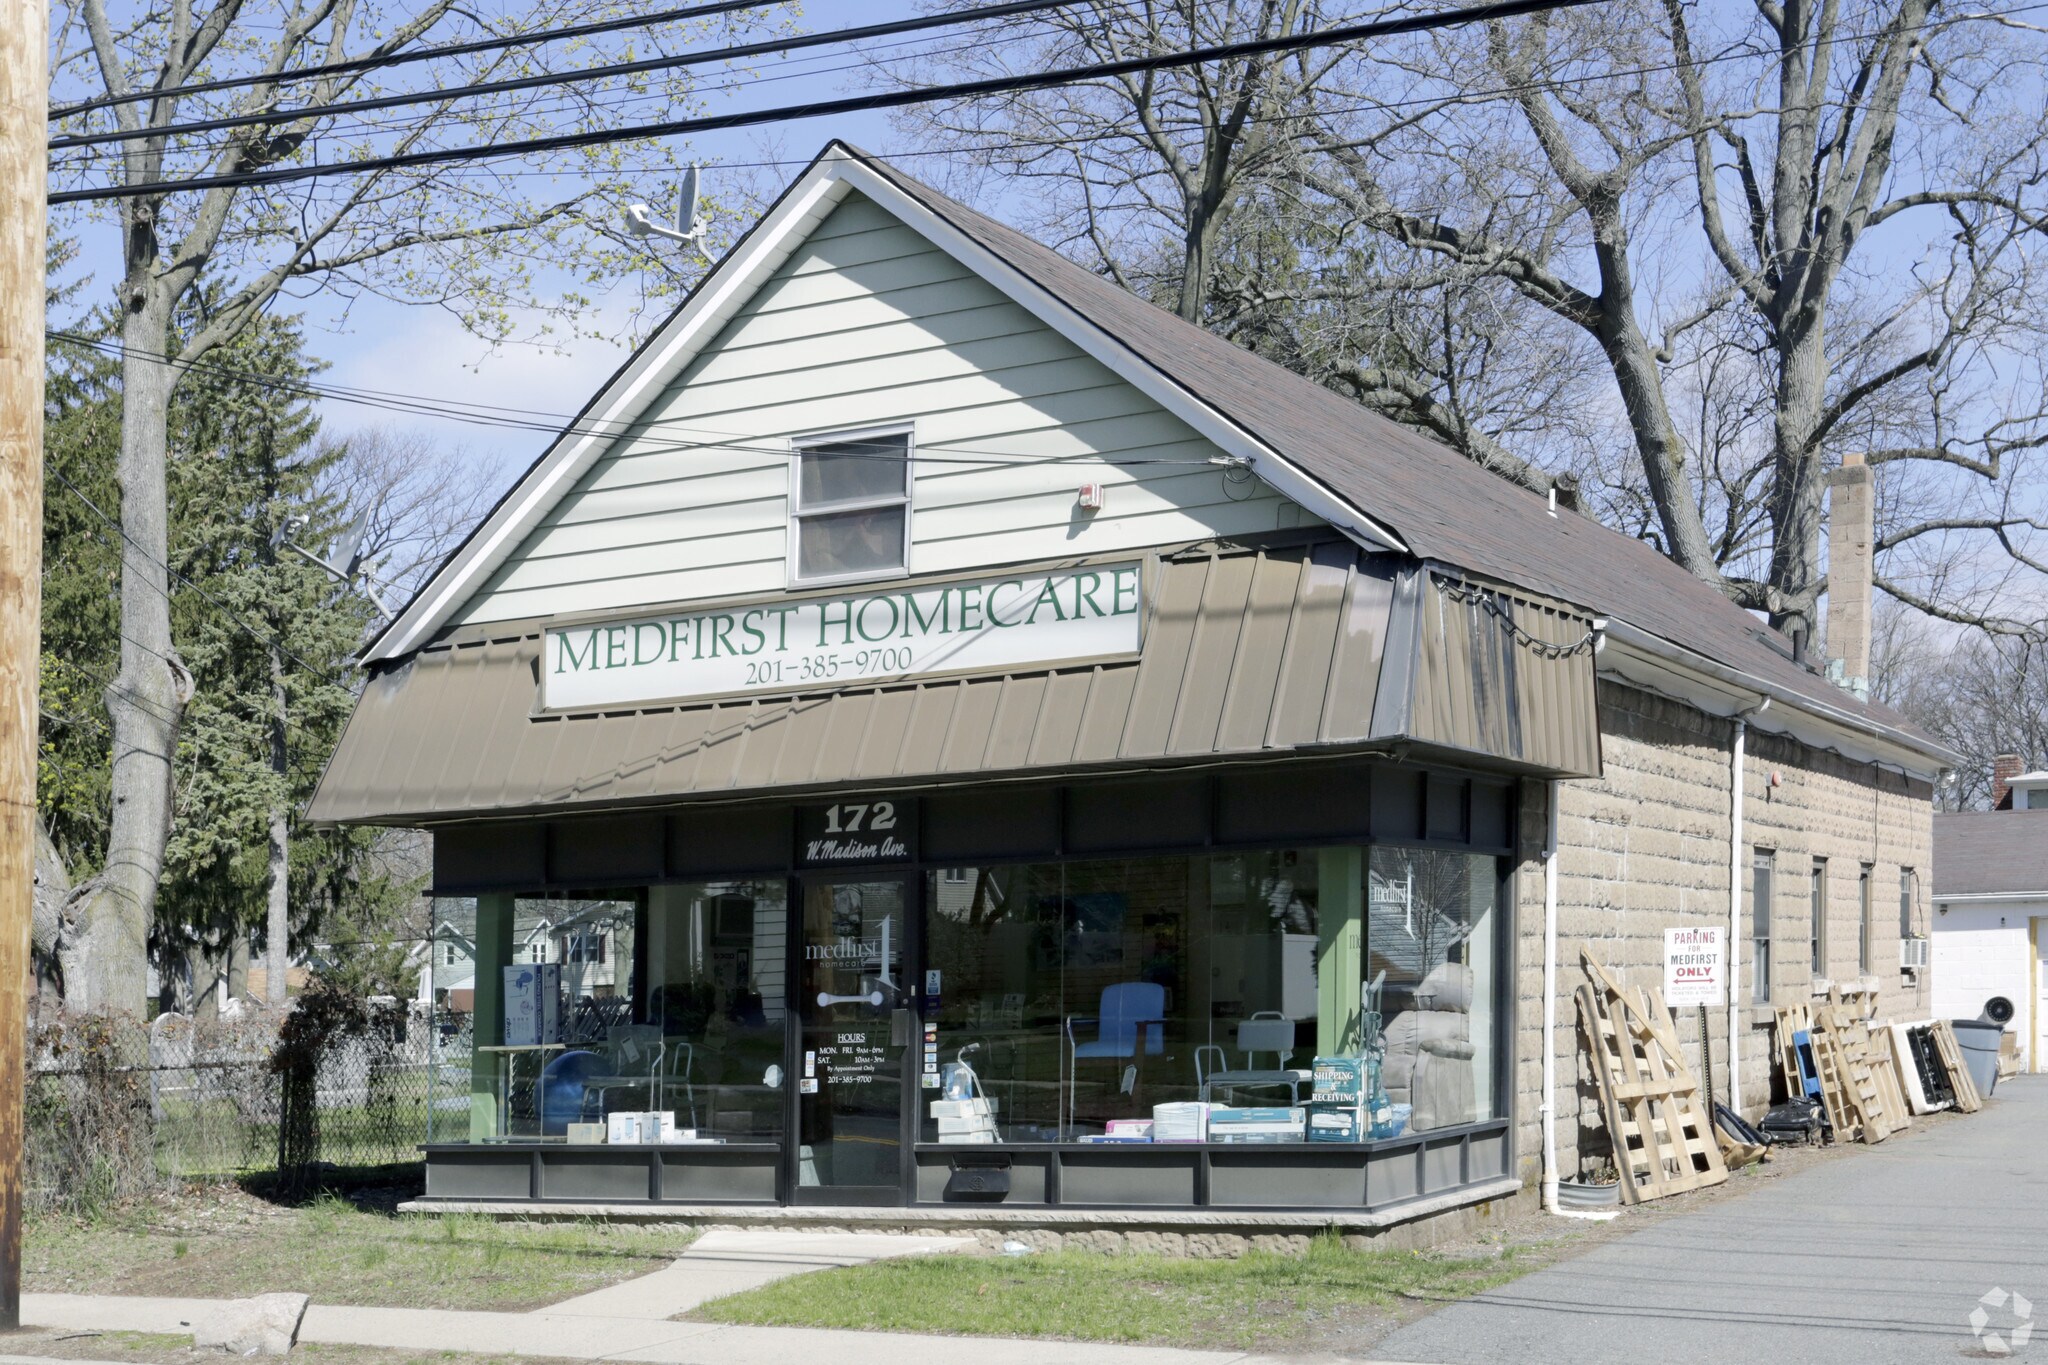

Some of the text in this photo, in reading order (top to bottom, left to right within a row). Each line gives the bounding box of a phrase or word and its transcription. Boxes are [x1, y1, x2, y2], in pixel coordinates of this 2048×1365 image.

[554, 567, 1139, 674] MEDFIRST HOMECARE
[744, 646, 913, 686] 201-385-9700
[825, 802, 897, 833] 172
[820, 838, 878, 859] Madison
[880, 836, 907, 857] Ave.
[1374, 879, 1407, 903] medfirst
[1674, 931, 1715, 944] PARKING
[805, 936, 879, 960] medfirst
[1671, 954, 1717, 965] MEDFIRST
[1676, 967, 1712, 976] ONLY
[837, 1033, 866, 1043] HOURS
[842, 1046, 853, 1054] FRI.
[817, 1056, 831, 1064] SAT.
[1313, 1071, 1354, 1080] SHIPPING
[1330, 1082, 1336, 1091] &
[1312, 1093, 1355, 1102] RECEIVING
